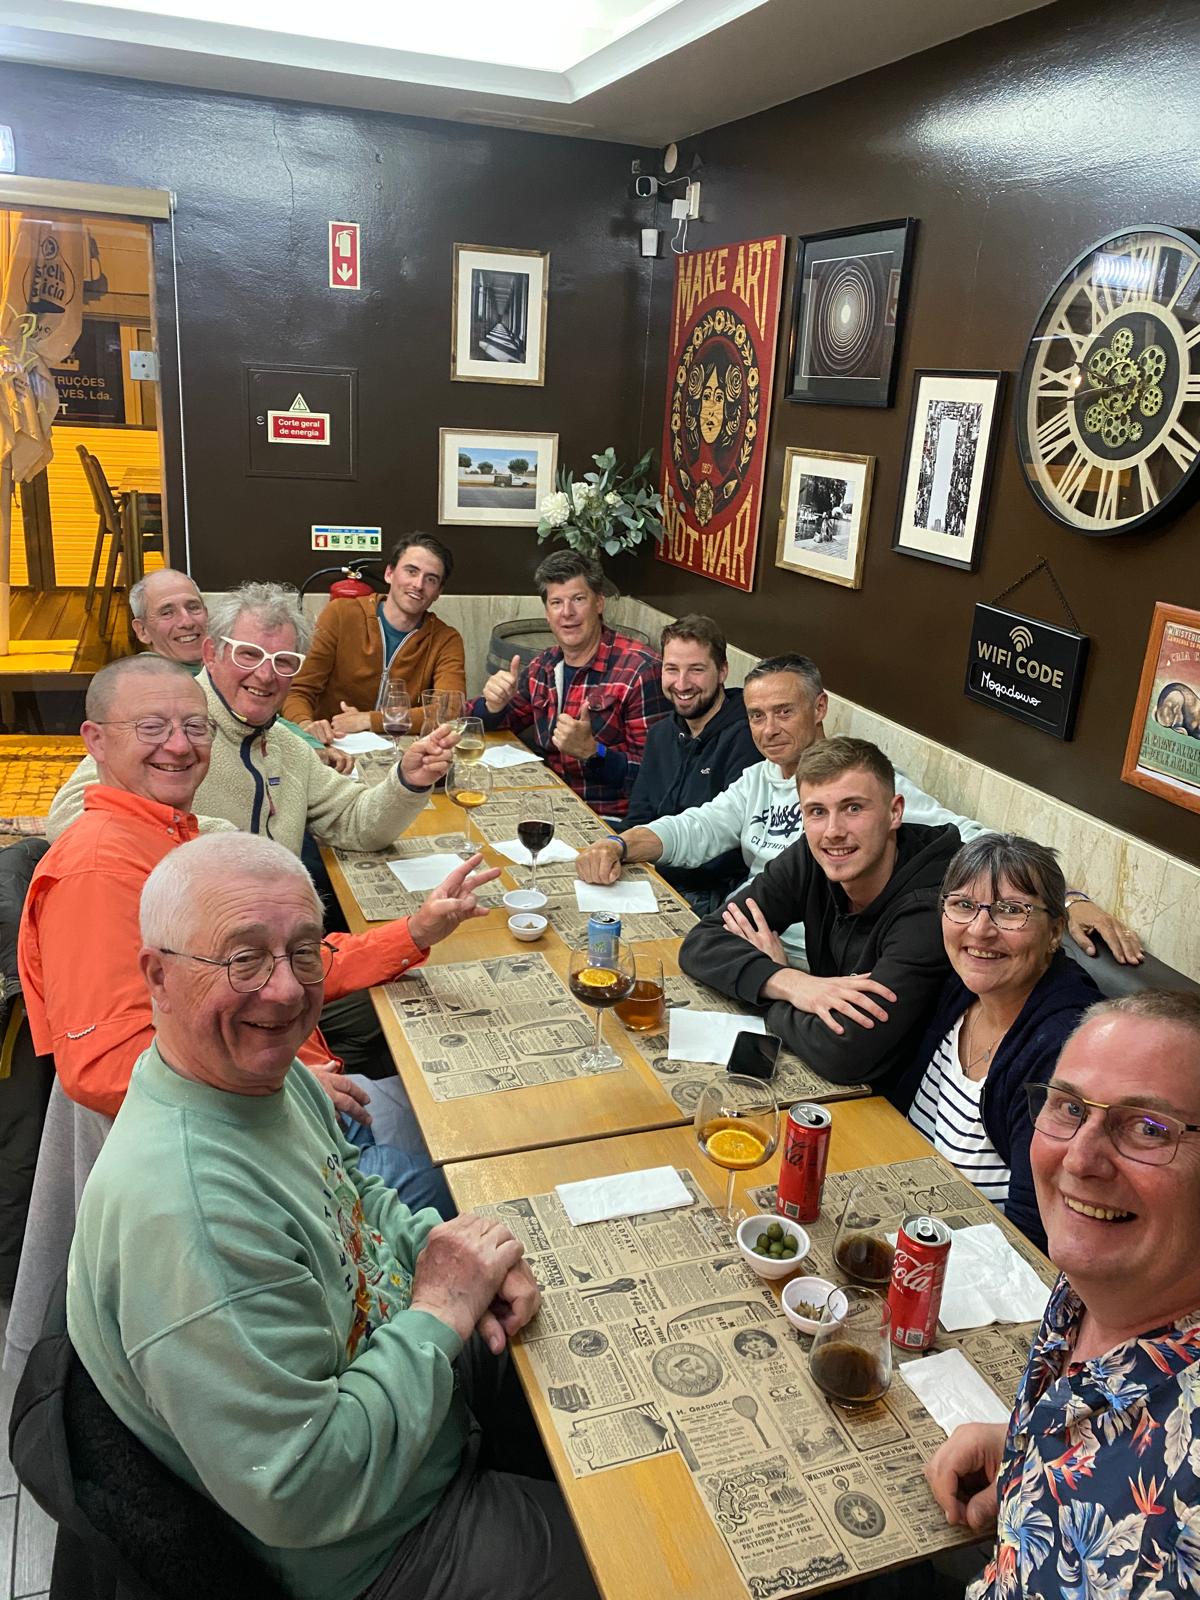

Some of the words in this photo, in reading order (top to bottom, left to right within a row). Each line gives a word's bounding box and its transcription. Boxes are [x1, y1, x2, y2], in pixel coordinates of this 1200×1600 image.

[673, 248, 729, 356] MAKE
[731, 239, 777, 342] ART
[54, 375, 106, 389] RUÇÕES
[58, 389, 88, 400] VES,
[278, 418, 299, 427] Corte
[300, 420, 320, 430] geral
[279, 427, 289, 435] de
[290, 429, 319, 438] energia
[658, 466, 700, 562] NOT
[699, 484, 754, 585] WAR
[976, 640, 1013, 669] WIFI
[1015, 656, 1065, 690] CODE
[980, 670, 1042, 708] Mogadouro
[612, 1218, 639, 1256] ALDPATE
[653, 1325, 669, 1346] THIR
[984, 1357, 1022, 1371] TRIUMPH
[806, 1467, 836, 1482] WALTHAM
